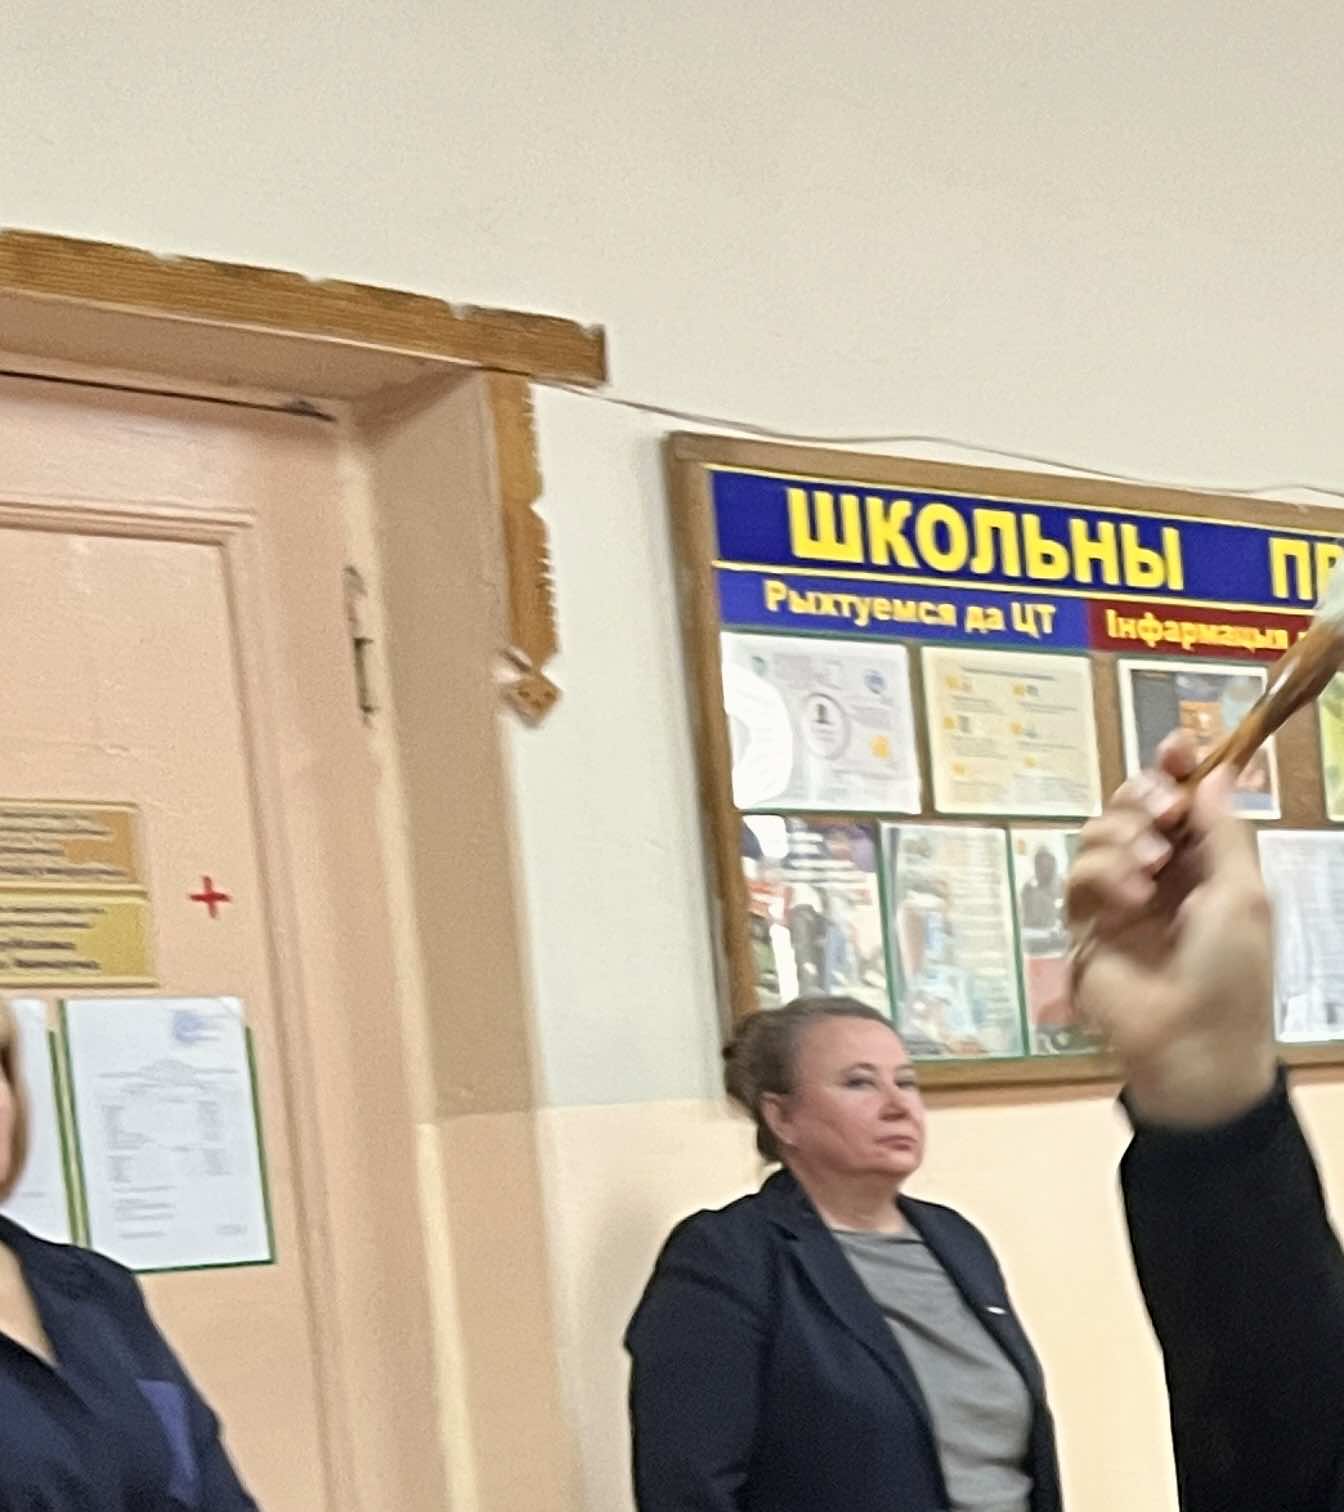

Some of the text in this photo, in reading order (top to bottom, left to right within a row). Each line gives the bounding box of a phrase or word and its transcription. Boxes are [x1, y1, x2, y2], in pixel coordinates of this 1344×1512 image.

[786, 487, 1184, 591] ШКОЛЬНЫ
[763, 580, 1057, 638] Рыхтуемся да ЦТ
